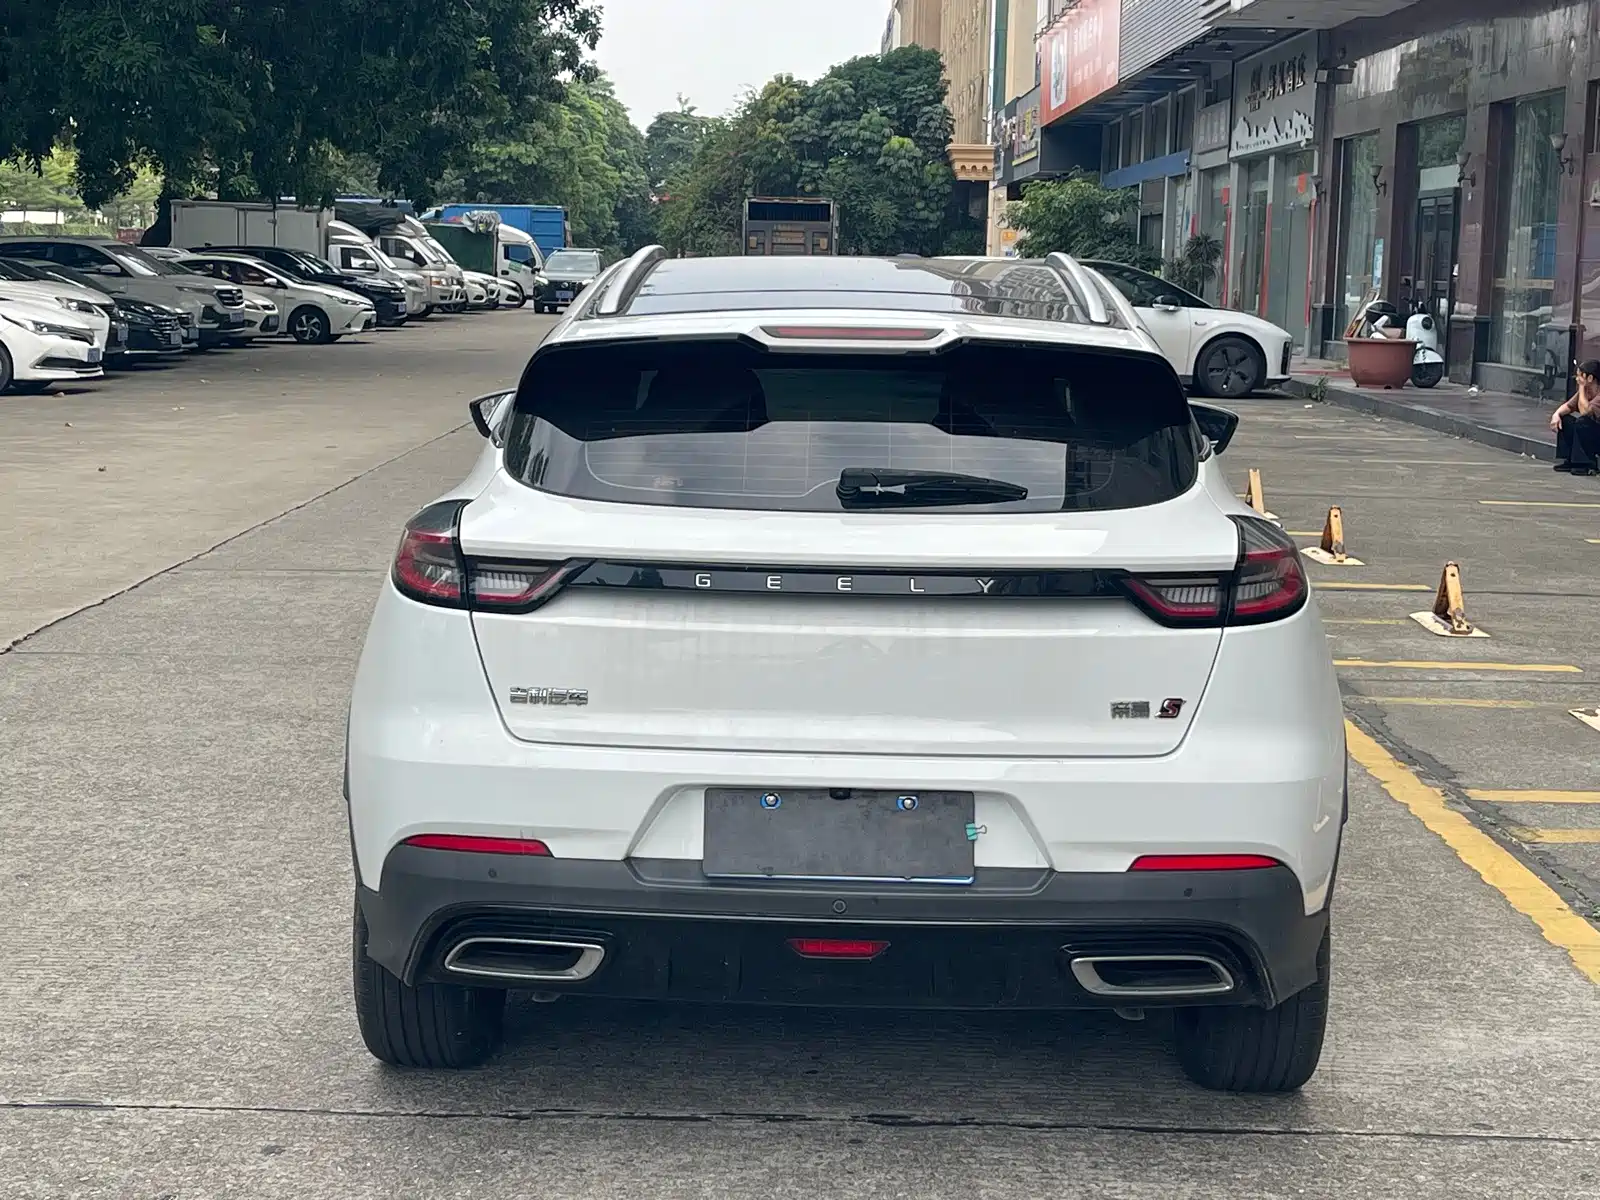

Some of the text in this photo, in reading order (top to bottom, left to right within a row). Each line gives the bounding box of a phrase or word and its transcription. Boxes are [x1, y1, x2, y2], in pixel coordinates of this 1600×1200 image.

[695, 574, 995, 595] GEELY
[509, 687, 588, 706] 吉利汽车
[1155, 698, 1187, 719] S
